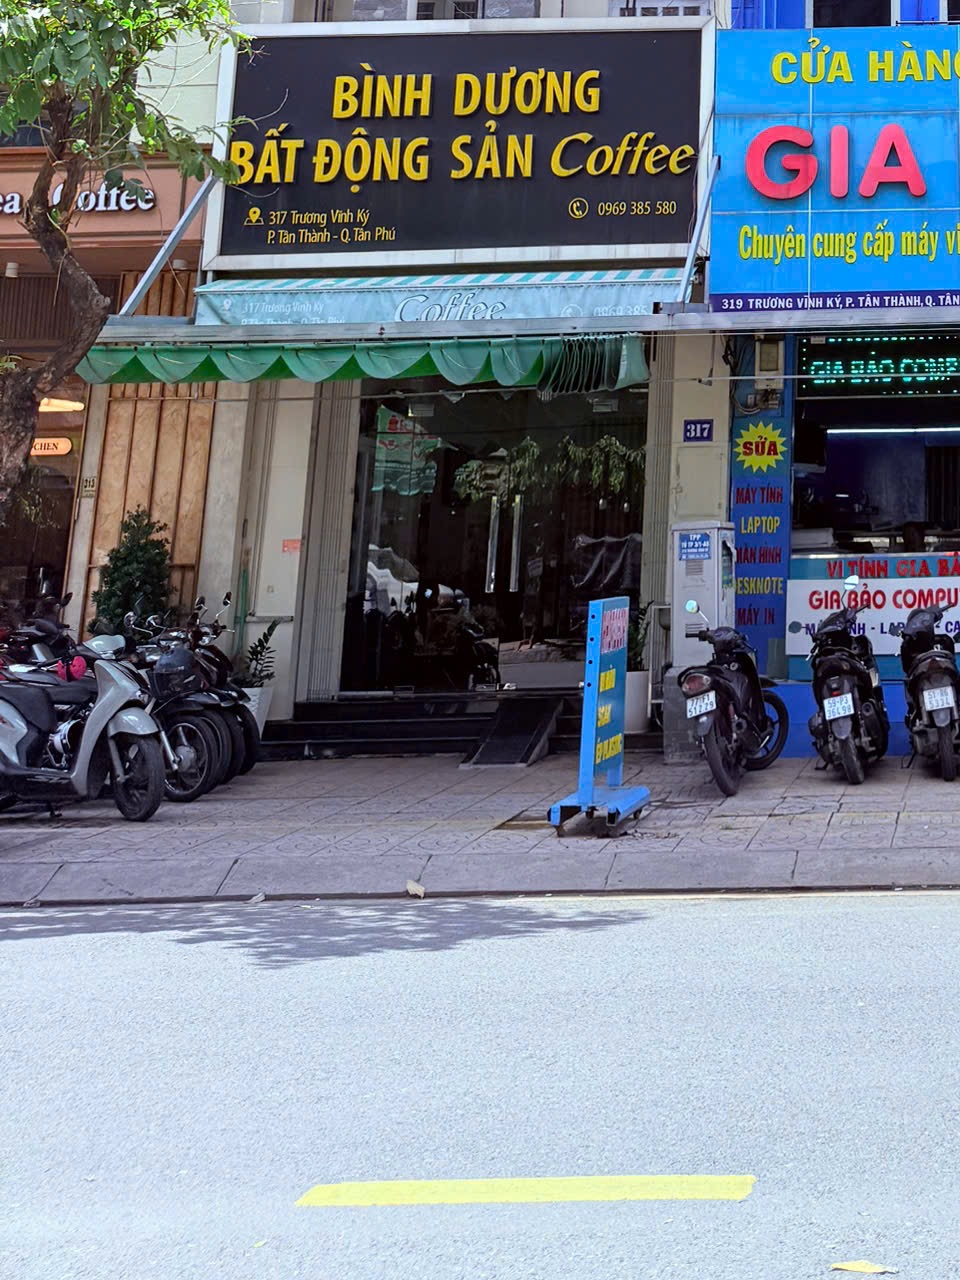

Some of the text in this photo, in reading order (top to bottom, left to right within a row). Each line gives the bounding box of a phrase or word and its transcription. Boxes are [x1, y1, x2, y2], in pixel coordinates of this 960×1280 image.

[771, 37, 853, 84] CỬA
[333, 63, 600, 119] BÌNH DƯƠNG
[229, 120, 694, 193] BẤT ĐỘNG SẢN Coffee
[745, 123, 927, 200] GIA
[269, 208, 370, 228] 317 Trương Vĩnh Ký
[598, 201, 677, 216] 0969 385 580
[267, 230, 275, 245] P.
[278, 230, 296, 244] Tân
[299, 228, 331, 243] Thành
[341, 228, 351, 243] Q.
[353, 227, 371, 241] Tân
[375, 226, 396, 241] Phú
[739, 224, 806, 265] Chuyên
[812, 232, 857, 264] cung
[862, 221, 894, 262] cấp
[901, 222, 938, 261] máy
[395, 292, 507, 321] Coffee
[721, 298, 744, 310] 319
[748, 296, 793, 310] TRƯƠNG
[797, 295, 823, 309] VĨNH
[826, 294, 844, 310] KÝ,
[846, 297, 855, 308] P.
[858, 293, 881, 308] TÂN
[938, 292, 960, 307] TÂN
[686, 422, 711, 439] 317
[33, 442, 59, 452] CHEN
[742, 435, 779, 457] SỬA
[736, 483, 783, 504] MÁY TÍNH
[741, 517, 780, 534] LAPTOP
[759, 542, 782, 564] HÌNH
[826, 560, 843, 579] VI
[847, 556, 889, 578] TÍNH
[896, 559, 931, 577] GIA
[809, 589, 841, 610] GIA
[848, 582, 887, 610] BẢO
[737, 603, 775, 626] MÁY IN
